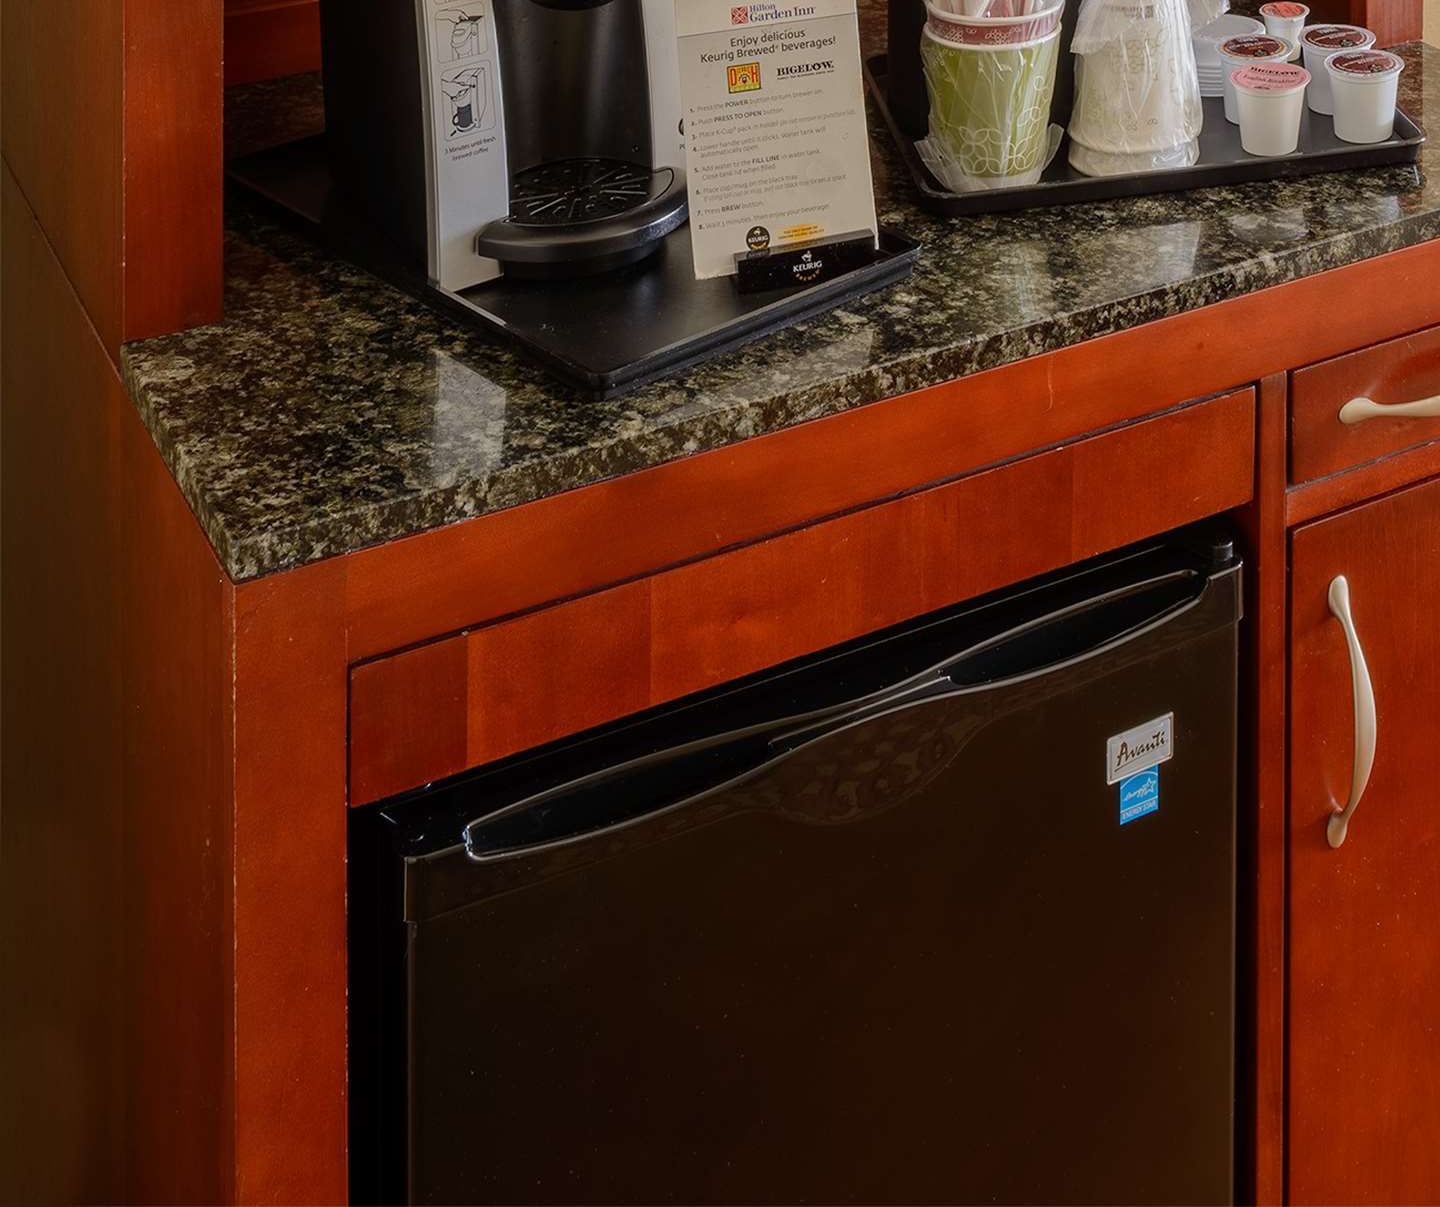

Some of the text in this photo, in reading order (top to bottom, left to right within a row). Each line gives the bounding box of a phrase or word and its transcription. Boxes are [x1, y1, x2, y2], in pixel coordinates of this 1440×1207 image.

[750, 3, 776, 13] Hilton
[750, 6, 815, 22] Garden Inn
[730, 29, 806, 48] Enjoy delicious
[700, 49, 735, 64] Keurig
[781, 36, 836, 52] beverages!
[777, 60, 834, 76] BIGELOW
[725, 98, 749, 108] POWER
[713, 114, 732, 122] PRESS
[744, 109, 762, 118] OPEN
[720, 203, 741, 212] BREW
[792, 260, 823, 273] KEURIG
[1116, 730, 1166, 767] Avanti
